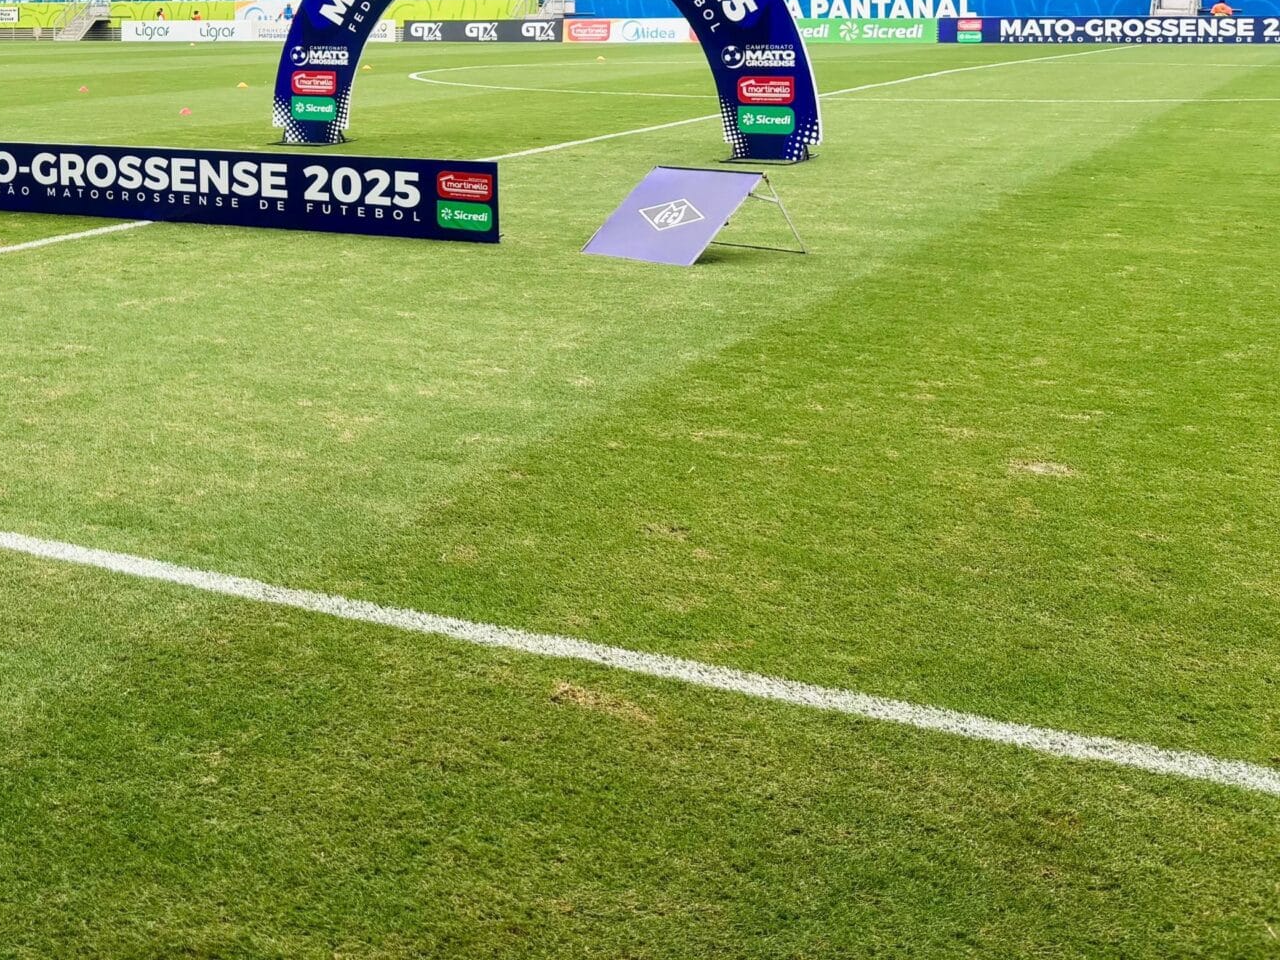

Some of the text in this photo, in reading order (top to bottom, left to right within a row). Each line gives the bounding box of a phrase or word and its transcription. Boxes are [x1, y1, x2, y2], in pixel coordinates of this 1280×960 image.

[862, 23, 924, 38] Sicredi
[1000, 18, 1255, 37] MATO-GROSSENSE
[1001, 36, 1083, 44] FEDERAÇÃO
[309, 50, 349, 59] MATO
[745, 50, 796, 60] MATO
[305, 104, 333, 113] Sicredi
[755, 115, 791, 125] Sicredi
[303, 165, 421, 208] 2025
[447, 181, 488, 190] martinello
[47, 187, 239, 208] MATOGROSSENSE
[259, 200, 285, 211] DE
[306, 202, 421, 222] FUTEBOL
[453, 210, 488, 222] Sicredi
